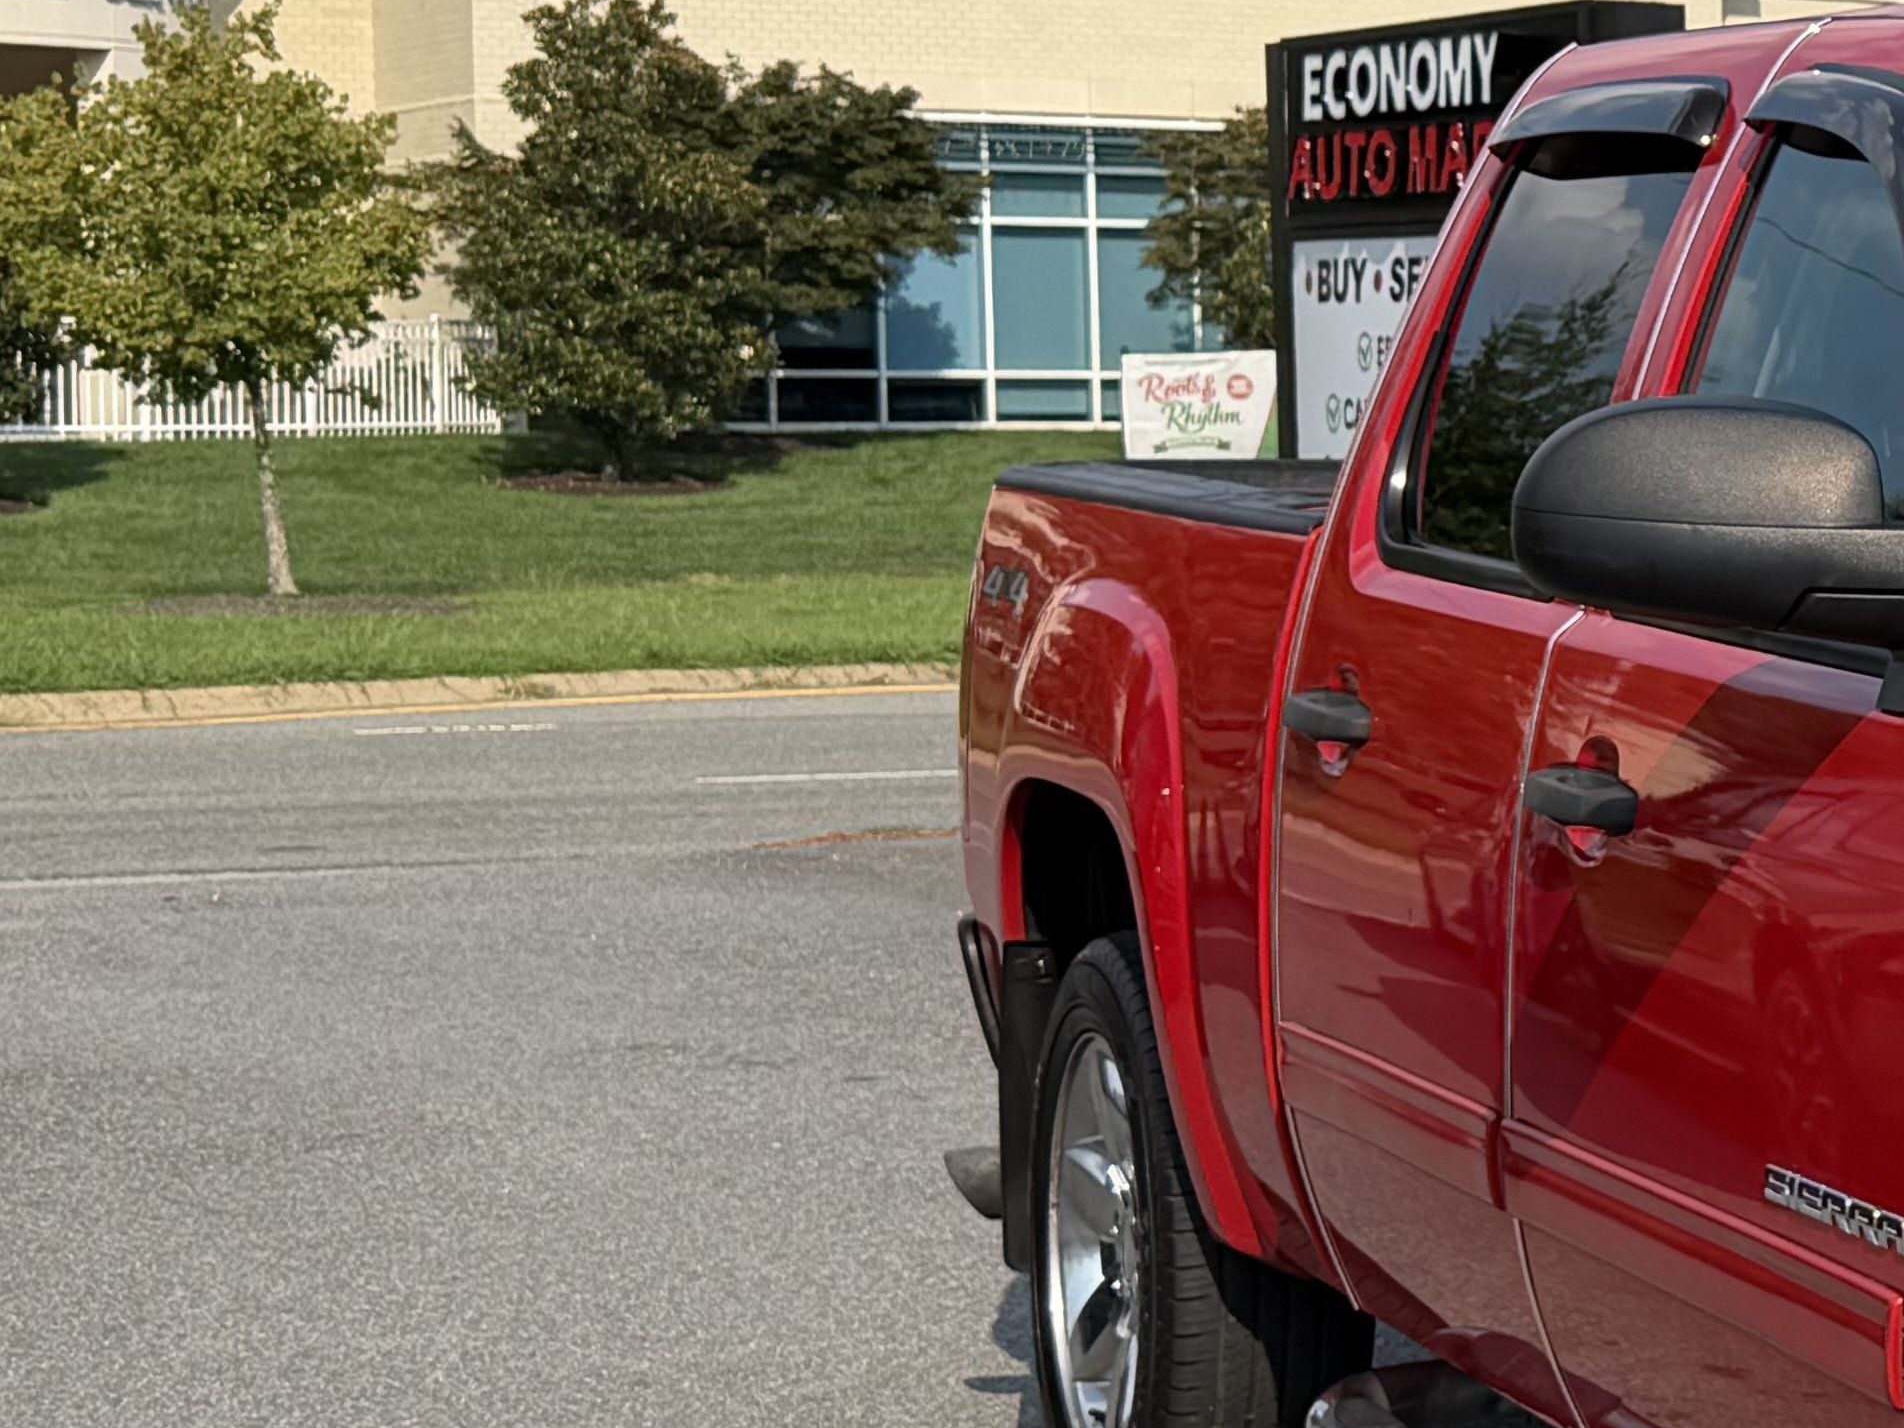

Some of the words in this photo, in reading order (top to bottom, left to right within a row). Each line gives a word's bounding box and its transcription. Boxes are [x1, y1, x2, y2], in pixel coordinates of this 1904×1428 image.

[1302, 31, 1499, 122] ECONOMY
[1287, 127, 1398, 201] AUTO
[1317, 257, 1368, 304] BUY
[1389, 255, 1428, 303] SE
[1161, 401, 1246, 434] Rhythm
